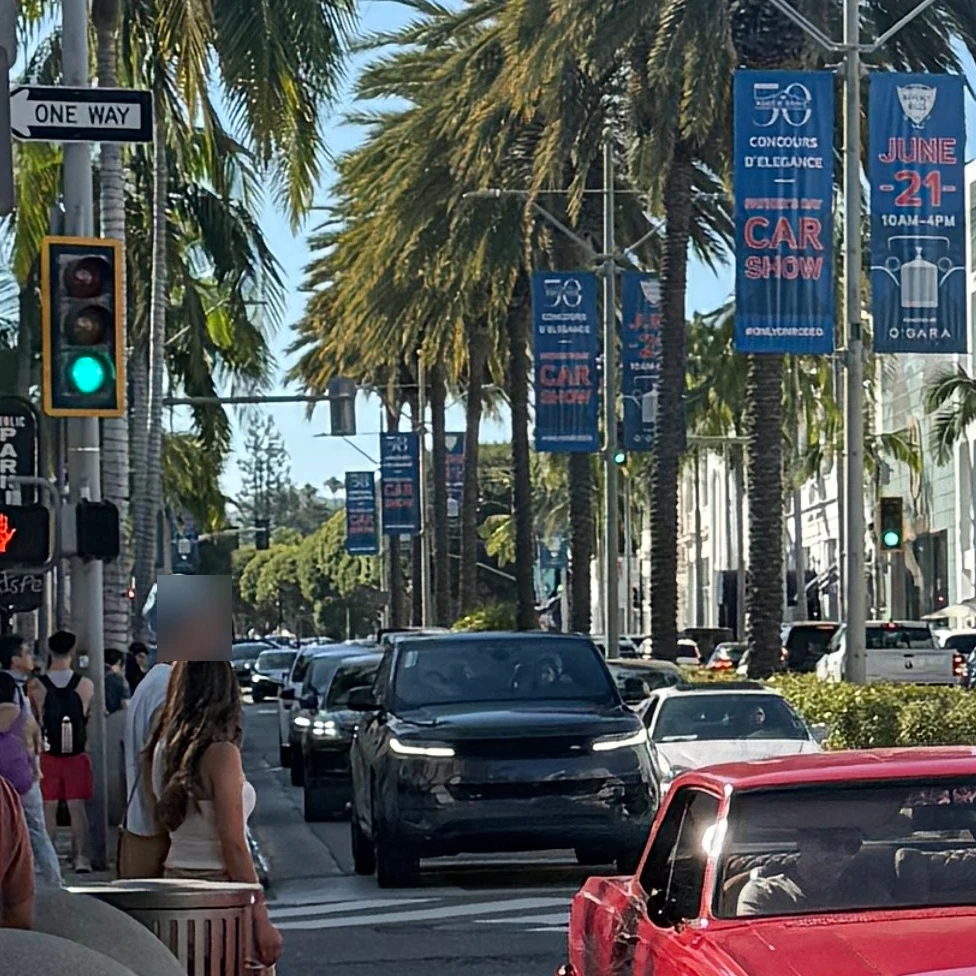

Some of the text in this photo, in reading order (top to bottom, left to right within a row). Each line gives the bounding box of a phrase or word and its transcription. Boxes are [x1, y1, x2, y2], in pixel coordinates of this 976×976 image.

[35, 104, 130, 125] ONE WAY
[749, 136, 818, 148] CONCOURS
[879, 137, 957, 164] JUNE
[744, 156, 823, 168] D'ELEGANCE
[744, 216, 823, 250] CAR
[744, 255, 823, 280] SHOW
[889, 327, 951, 339] O'GARA
[540, 364, 591, 386] CAR
